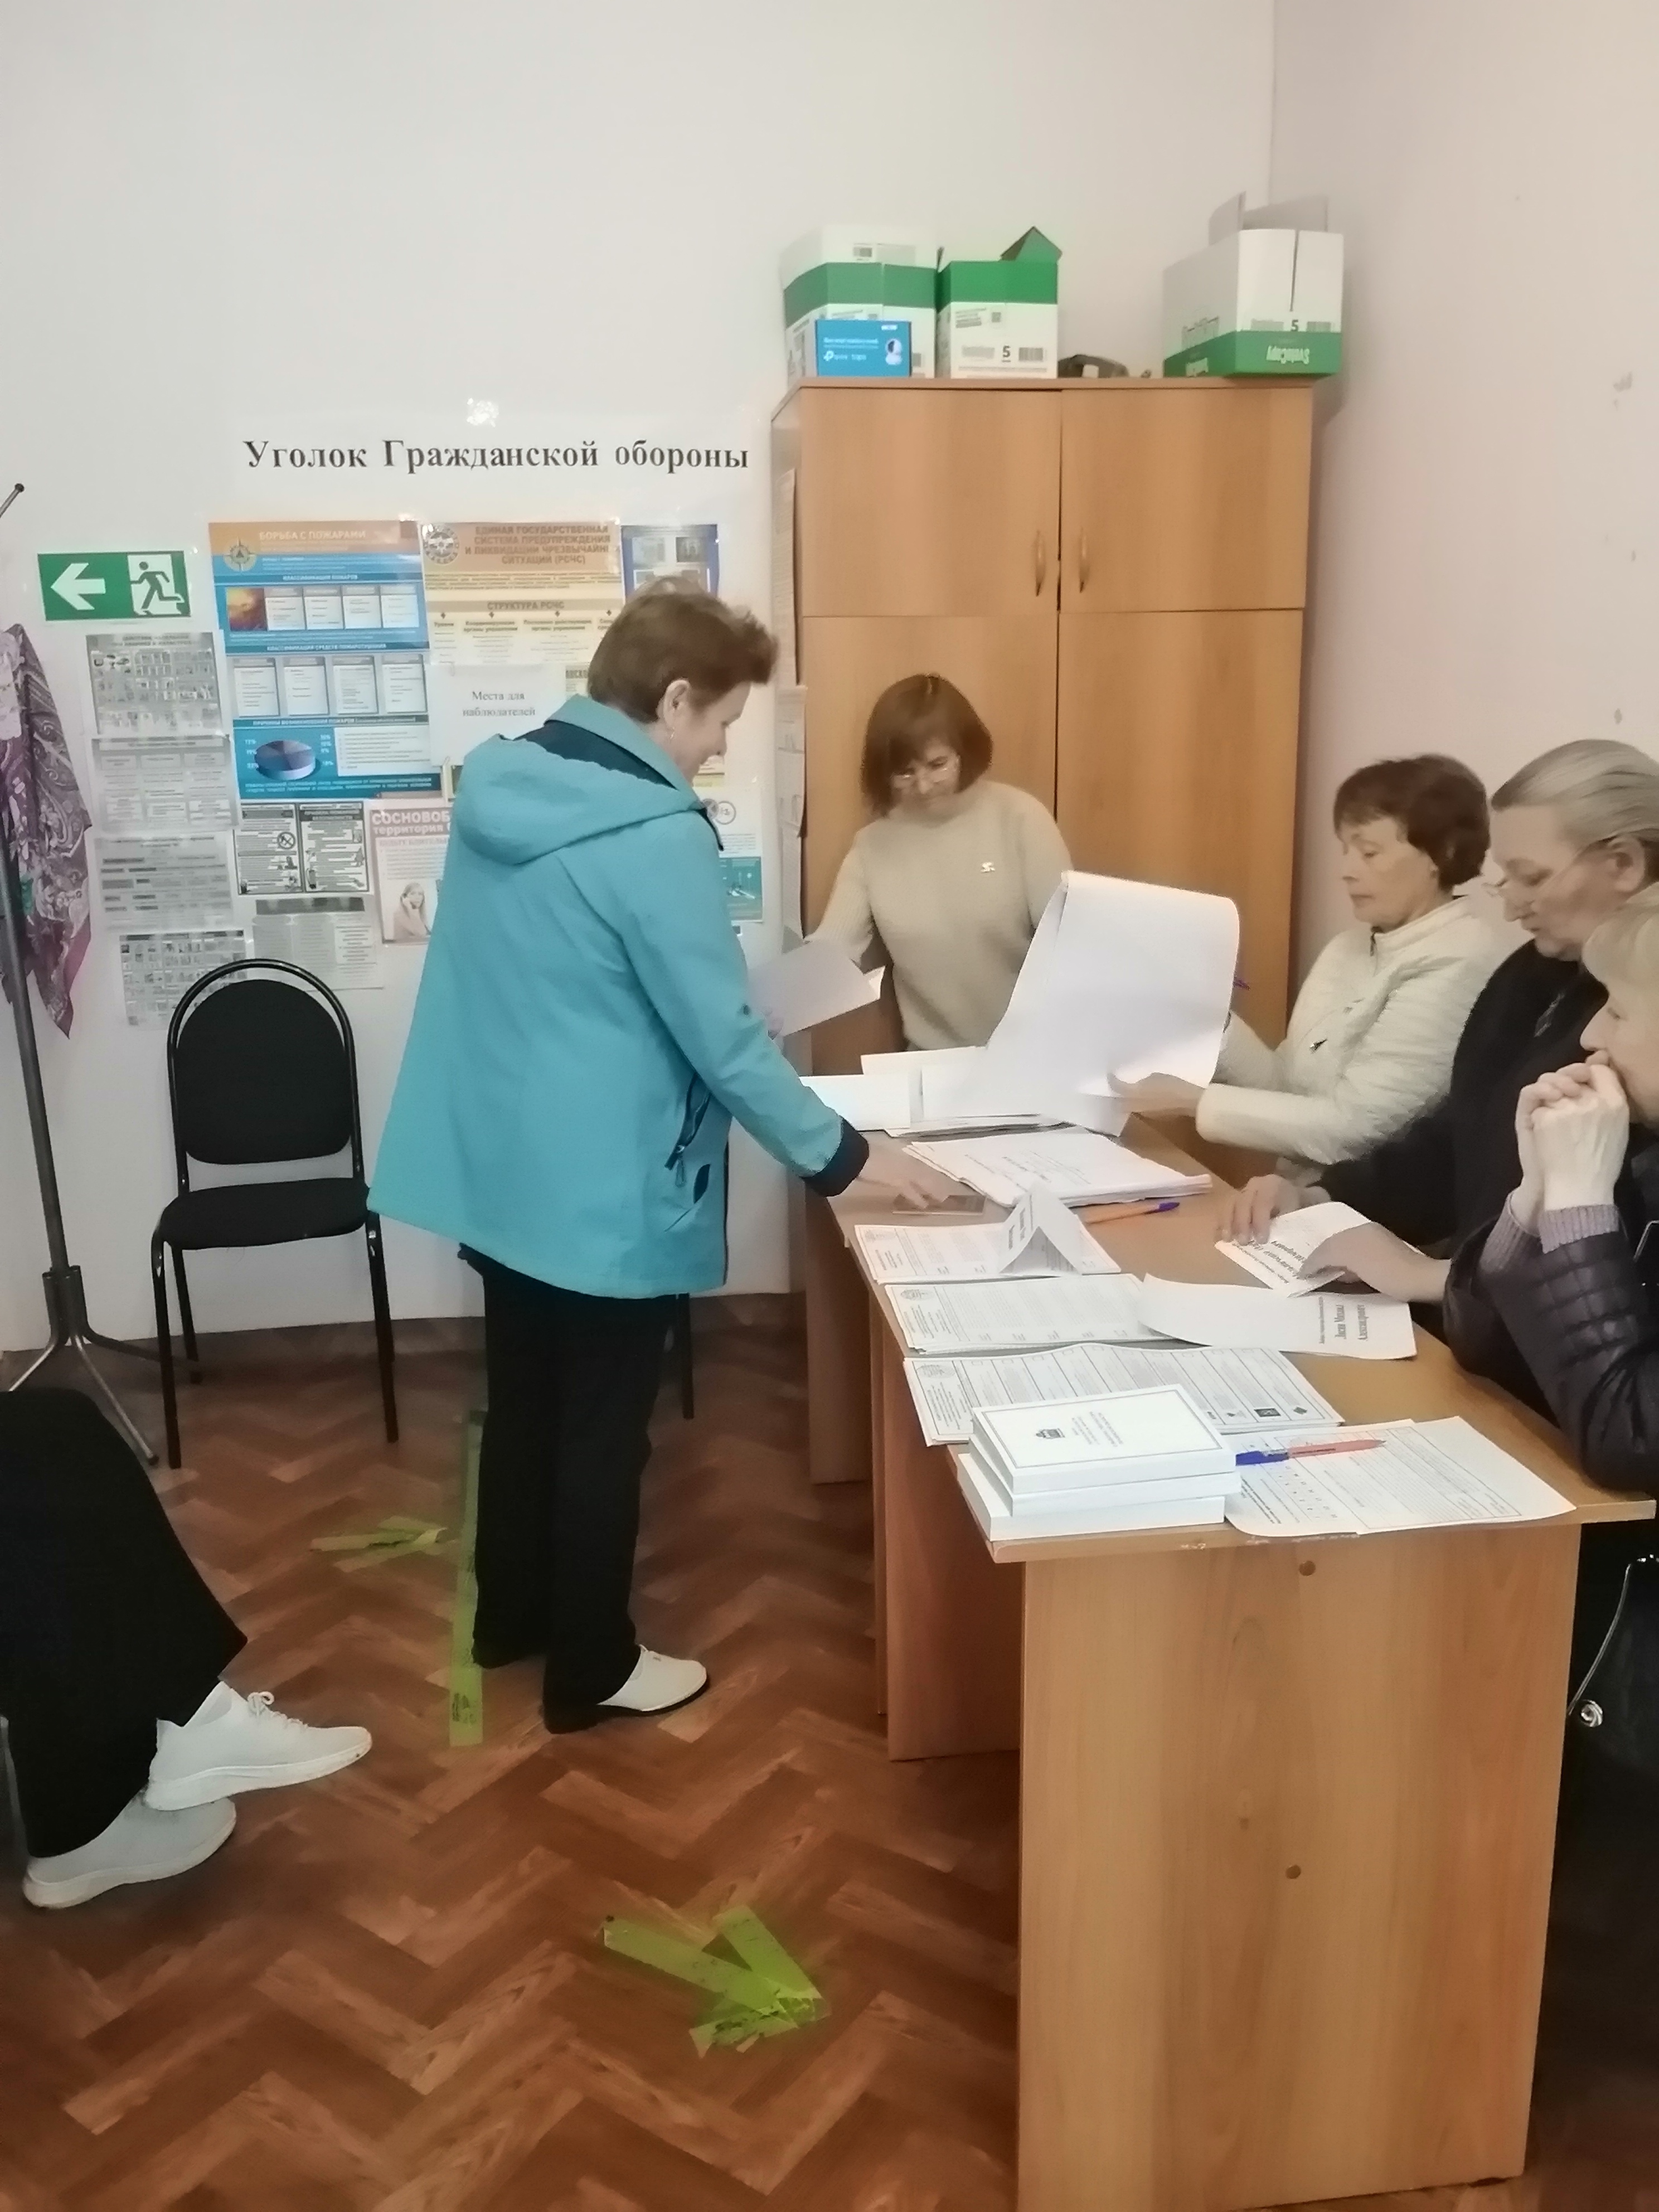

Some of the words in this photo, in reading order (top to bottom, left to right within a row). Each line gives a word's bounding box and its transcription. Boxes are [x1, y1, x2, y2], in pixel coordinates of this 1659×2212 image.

[1002, 346, 1011, 358] 5
[242, 440, 367, 468] Уголок
[382, 439, 599, 474] Гражданской
[615, 439, 748, 474] обороны
[475, 526, 513, 535] ЕДИНАЯ
[516, 525, 608, 534] ГОСУДАРСТВЕННАЯ
[259, 531, 297, 540] БОРЬБА
[308, 531, 366, 540] ПОЖАРАМИ
[522, 535, 610, 544] ПРЕДУПРЕЖДЕНИЯ
[487, 601, 538, 610] СТРУКТУРА
[472, 691, 505, 701] Места
[507, 692, 525, 701] для
[462, 706, 536, 717] наблюдателей
[373, 824, 444, 836] территория
